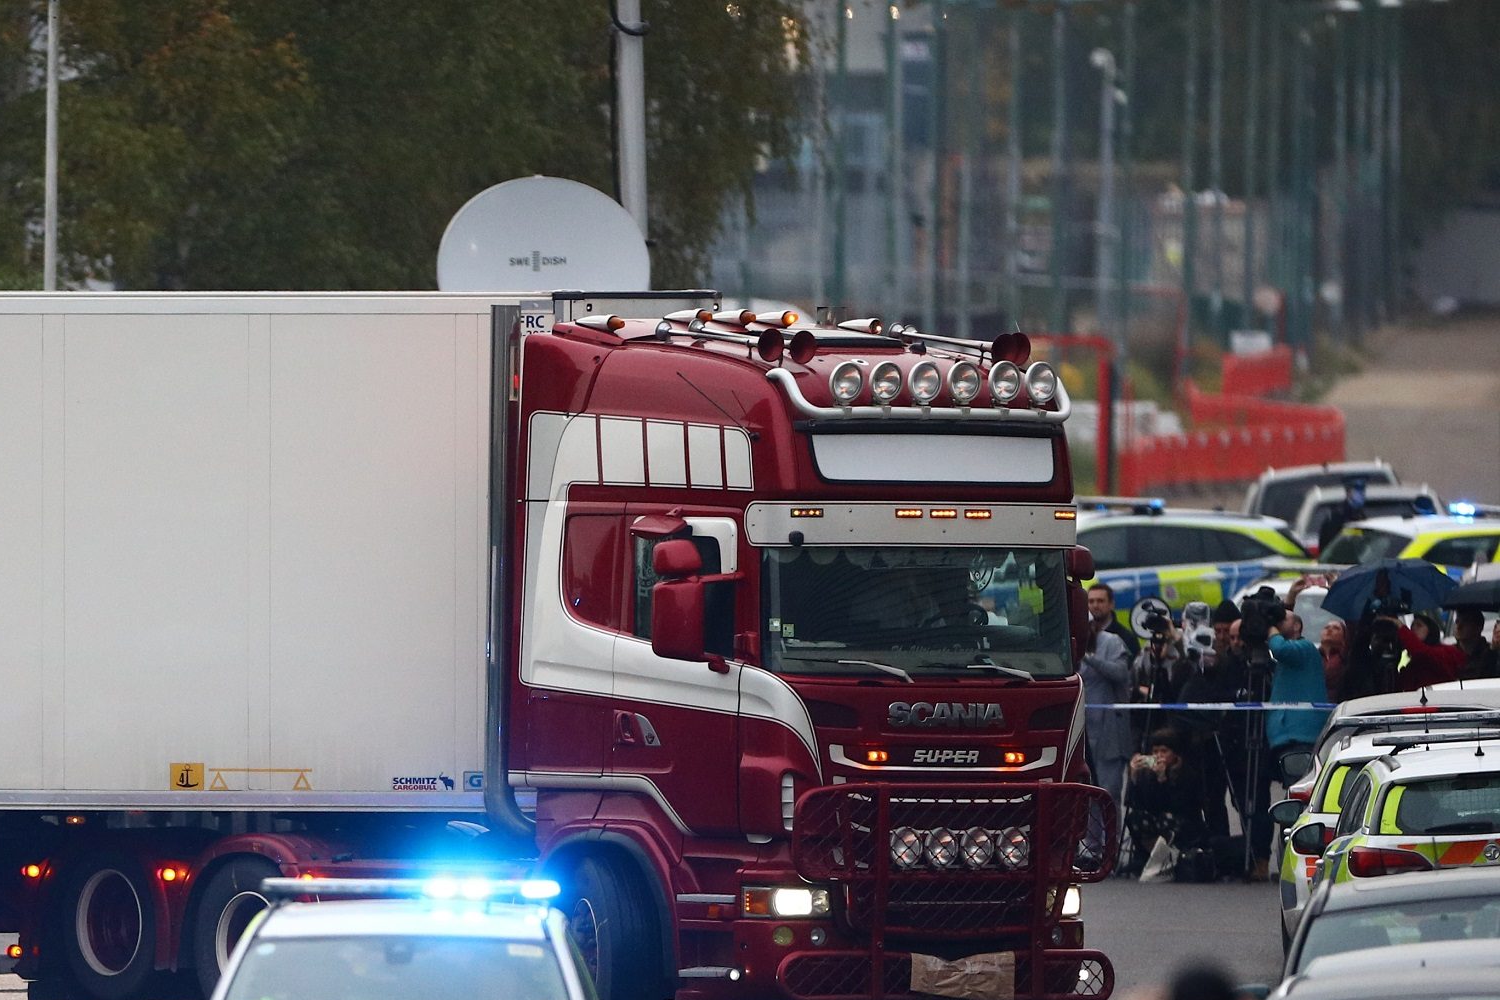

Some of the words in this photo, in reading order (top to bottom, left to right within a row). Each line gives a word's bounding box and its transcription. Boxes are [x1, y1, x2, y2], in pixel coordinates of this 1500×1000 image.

[887, 701, 1006, 727] SCANIA
[913, 749, 979, 763] SUPER
[392, 777, 437, 785] SCHMITZ
